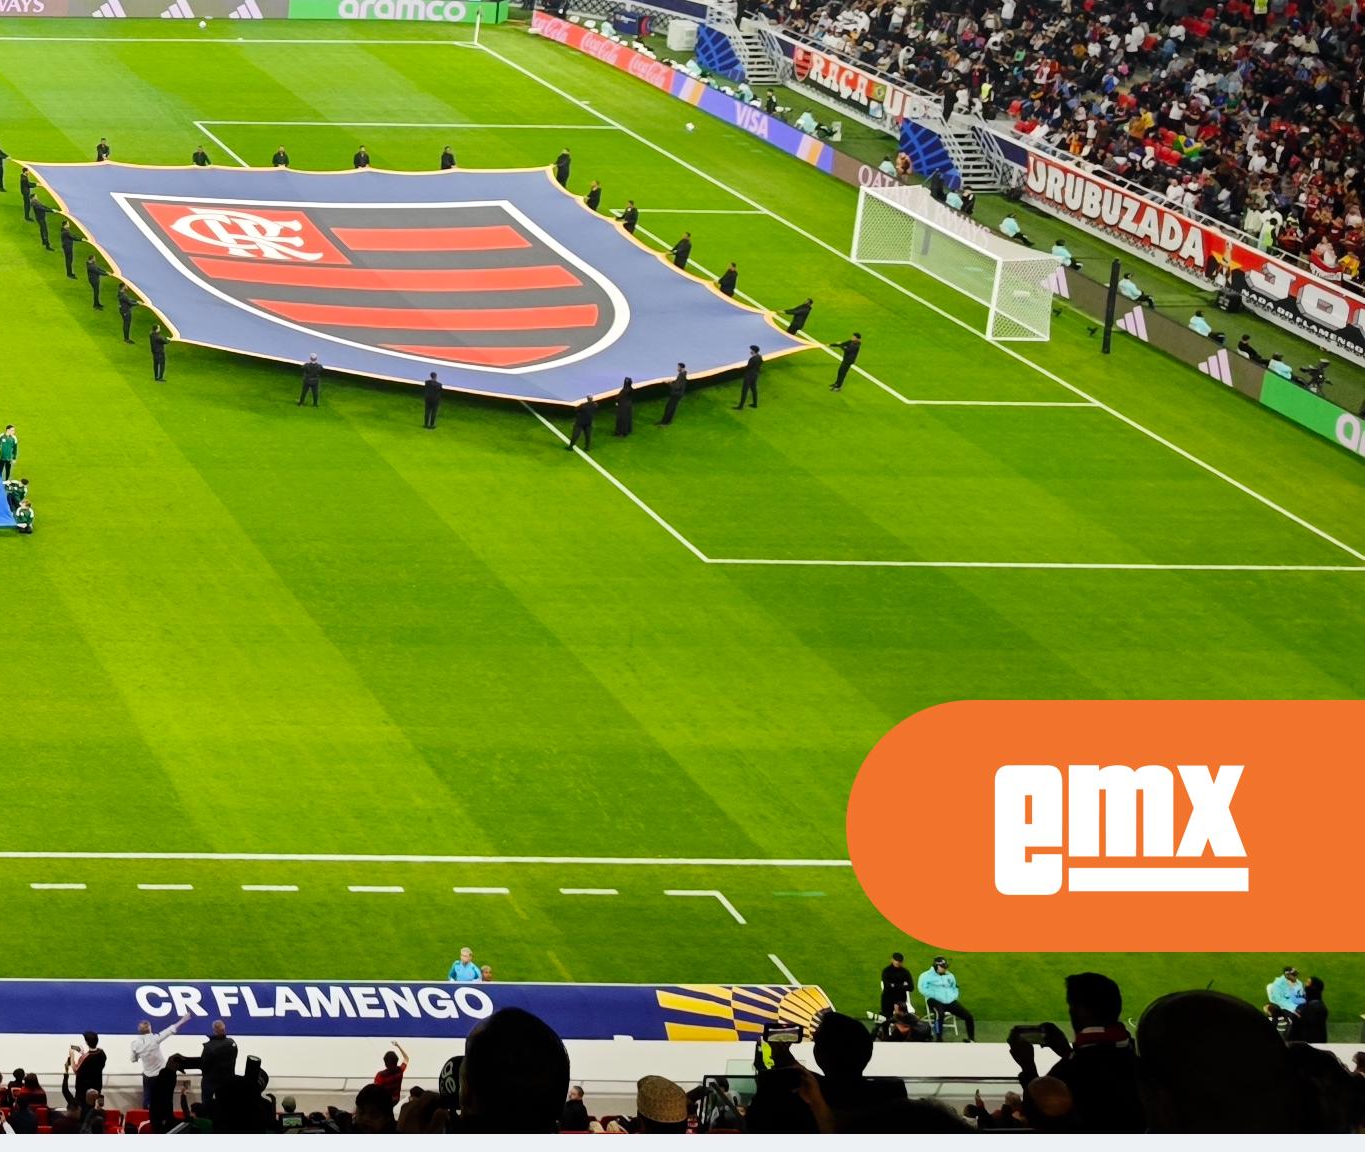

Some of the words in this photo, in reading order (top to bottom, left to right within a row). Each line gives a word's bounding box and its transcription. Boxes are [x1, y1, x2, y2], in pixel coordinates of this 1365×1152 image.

[809, 51, 870, 107] RAÇA
[733, 102, 770, 139] VISA
[1027, 156, 1205, 268] URUBUZADA
[1276, 306, 1294, 321] DO
[136, 984, 209, 1018] CR
[211, 985, 494, 1020] FLAMENGO
